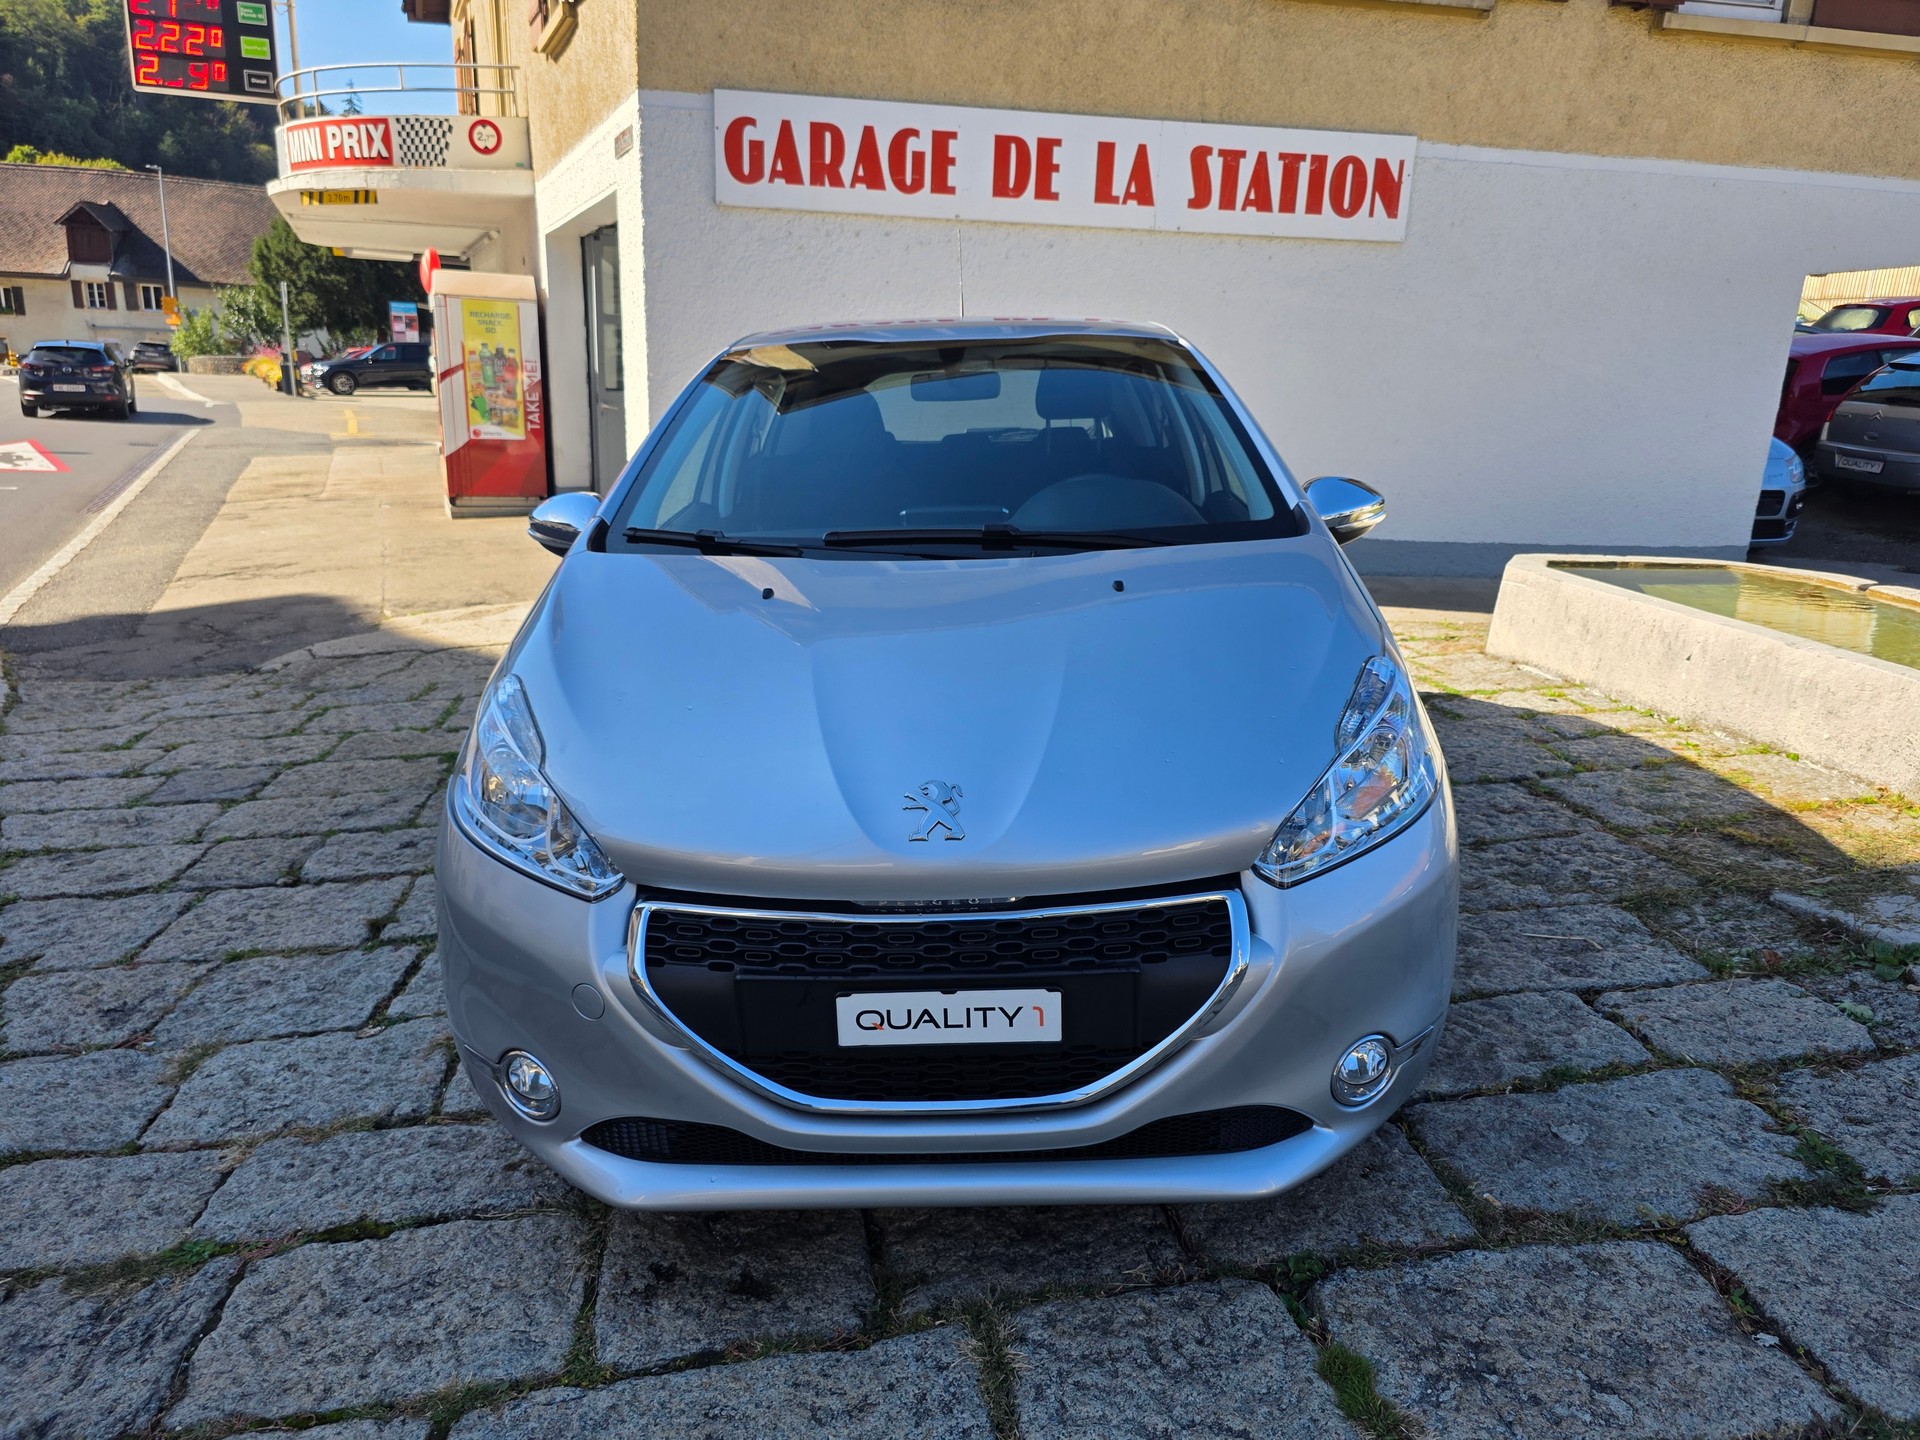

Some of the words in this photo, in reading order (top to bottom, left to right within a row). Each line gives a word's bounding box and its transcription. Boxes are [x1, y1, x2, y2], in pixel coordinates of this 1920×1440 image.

[288, 127, 323, 164] MINI
[324, 123, 390, 160] PRIX
[723, 115, 959, 196] GARAGE
[992, 133, 1063, 201] DE
[1094, 140, 1155, 207] LA
[1187, 143, 1406, 220] STATION
[524, 359, 538, 391] ME!
[526, 392, 541, 431] TAKE
[855, 1005, 1024, 1030] QUALITY
[1031, 1005, 1045, 1027] 1
